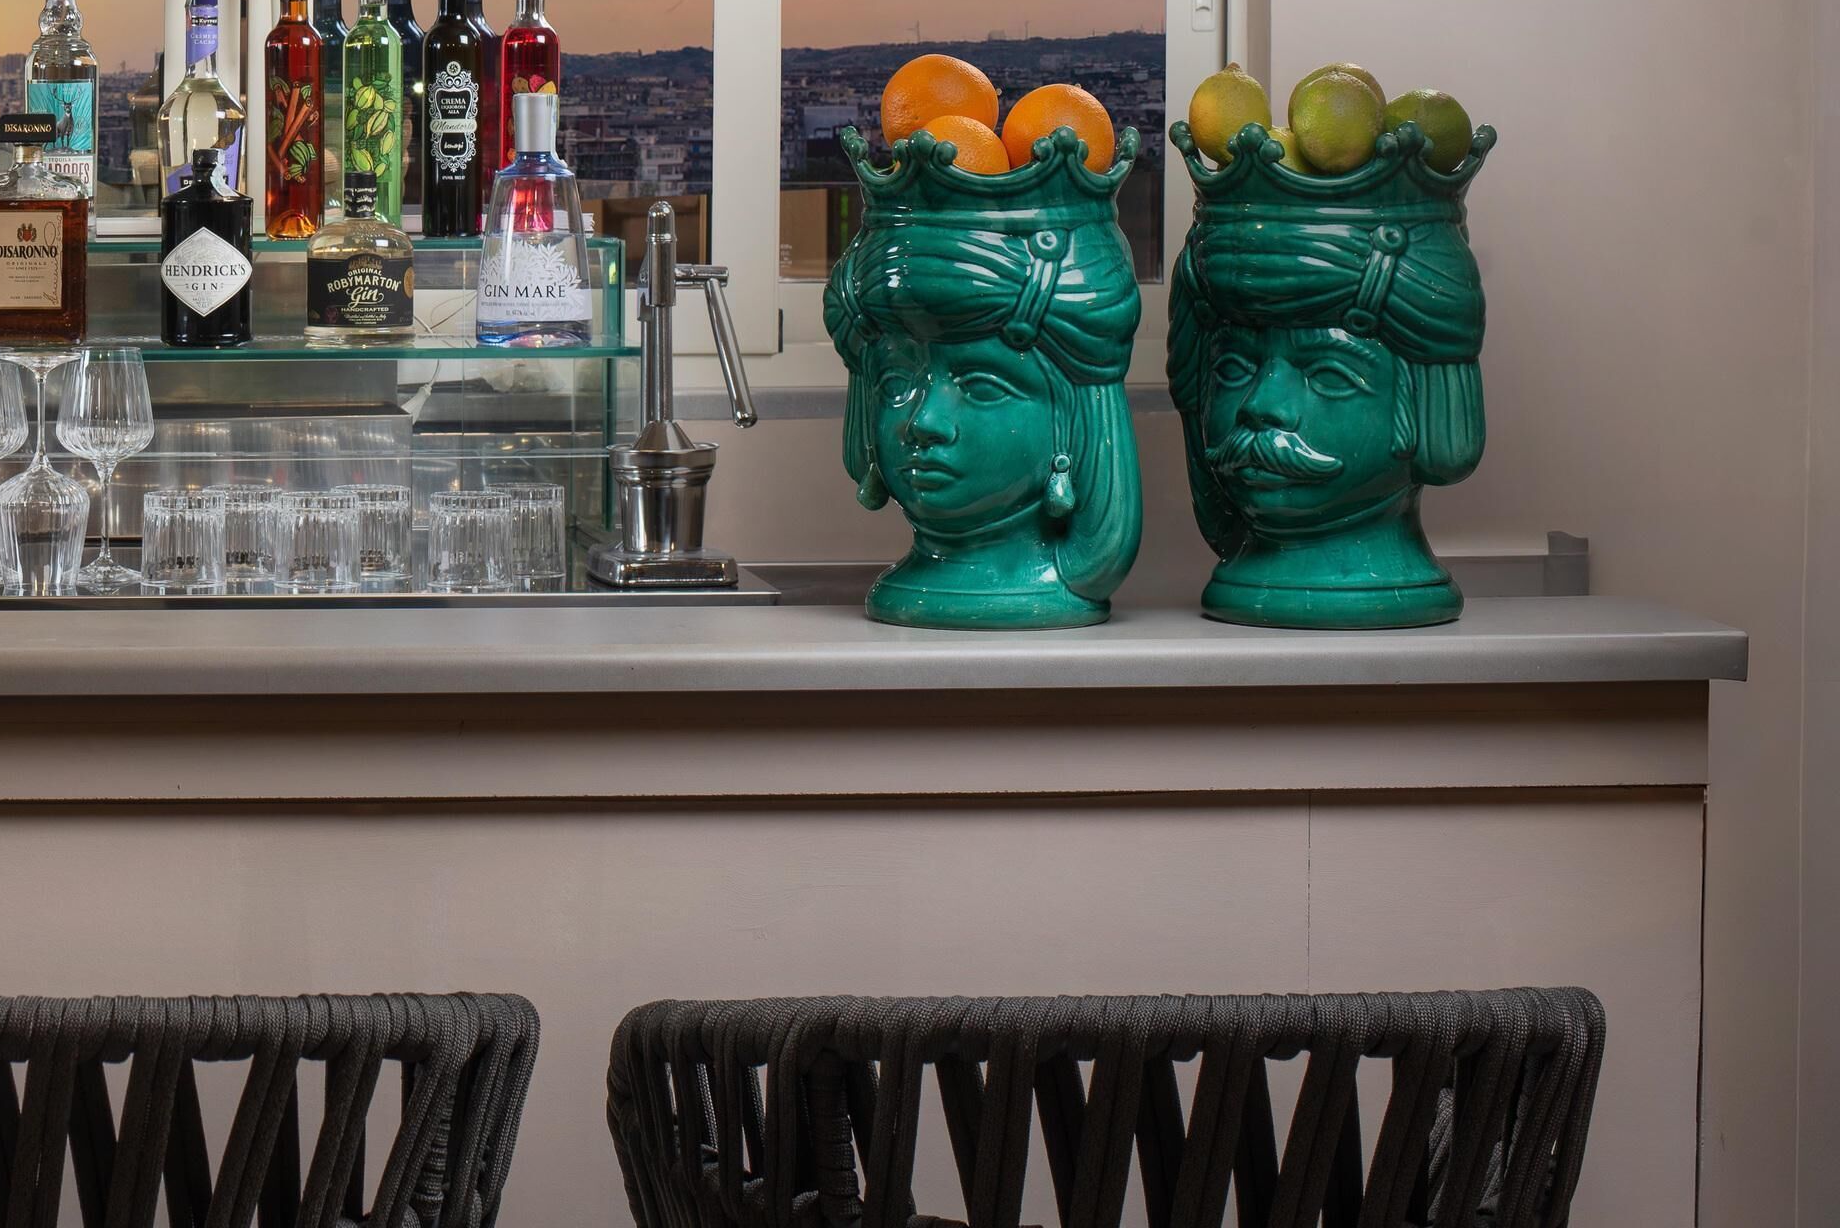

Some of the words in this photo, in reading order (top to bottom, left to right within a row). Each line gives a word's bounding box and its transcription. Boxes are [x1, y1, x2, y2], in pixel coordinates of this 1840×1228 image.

[4, 124, 52, 132] DISARONNO
[165, 264, 246, 277] HENDRICK'S
[347, 268, 382, 276] ORIGINAL
[327, 276, 399, 293] ROBYMARTON
[484, 284, 509, 298] GIN
[346, 286, 385, 308] Gin
